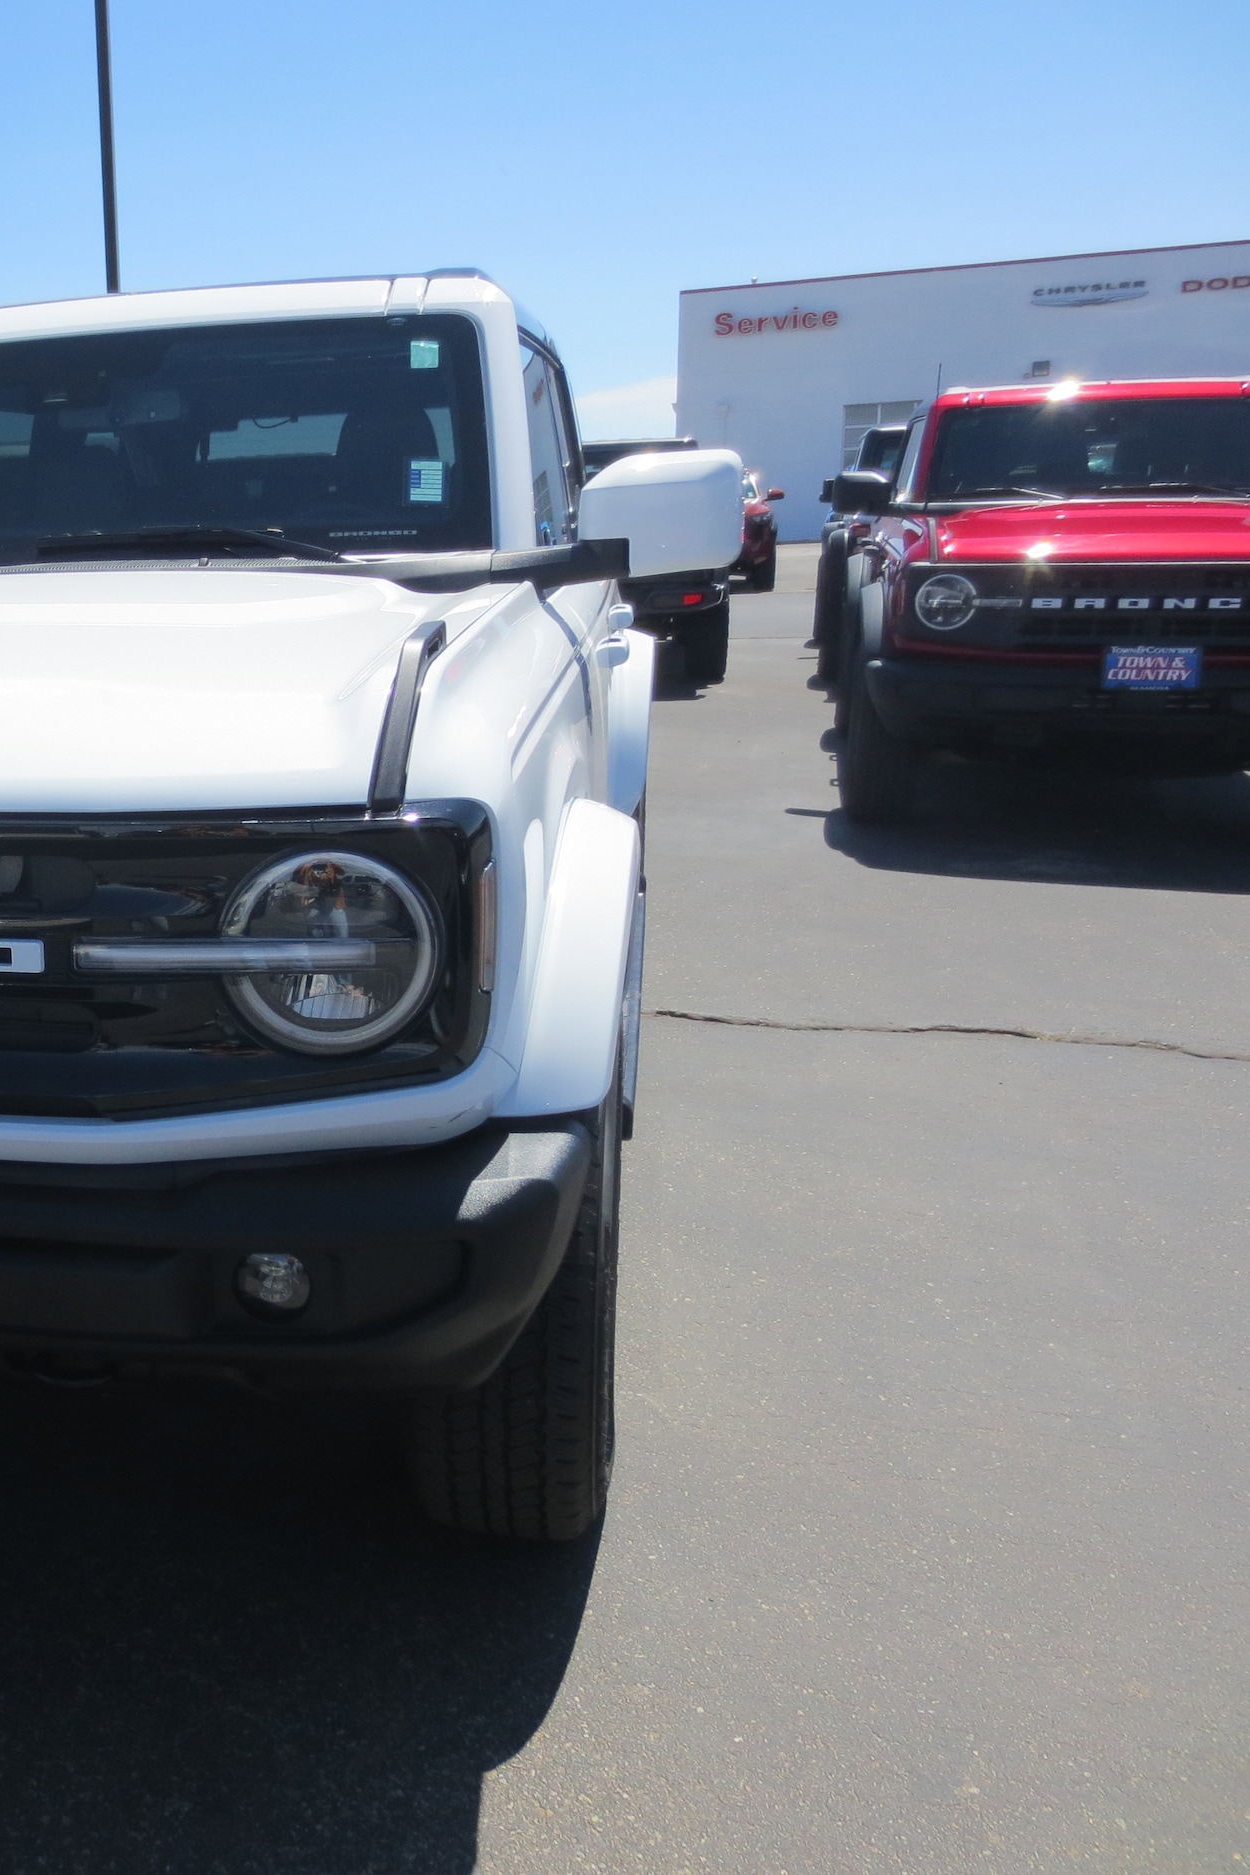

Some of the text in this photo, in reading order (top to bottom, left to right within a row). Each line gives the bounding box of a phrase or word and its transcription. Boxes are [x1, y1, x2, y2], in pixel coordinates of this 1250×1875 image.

[1032, 280, 1146, 296] CHRYSLER
[714, 306, 839, 336] Service
[1117, 656, 1186, 668] TOWN &
[1107, 668, 1192, 680] COUNTRY
